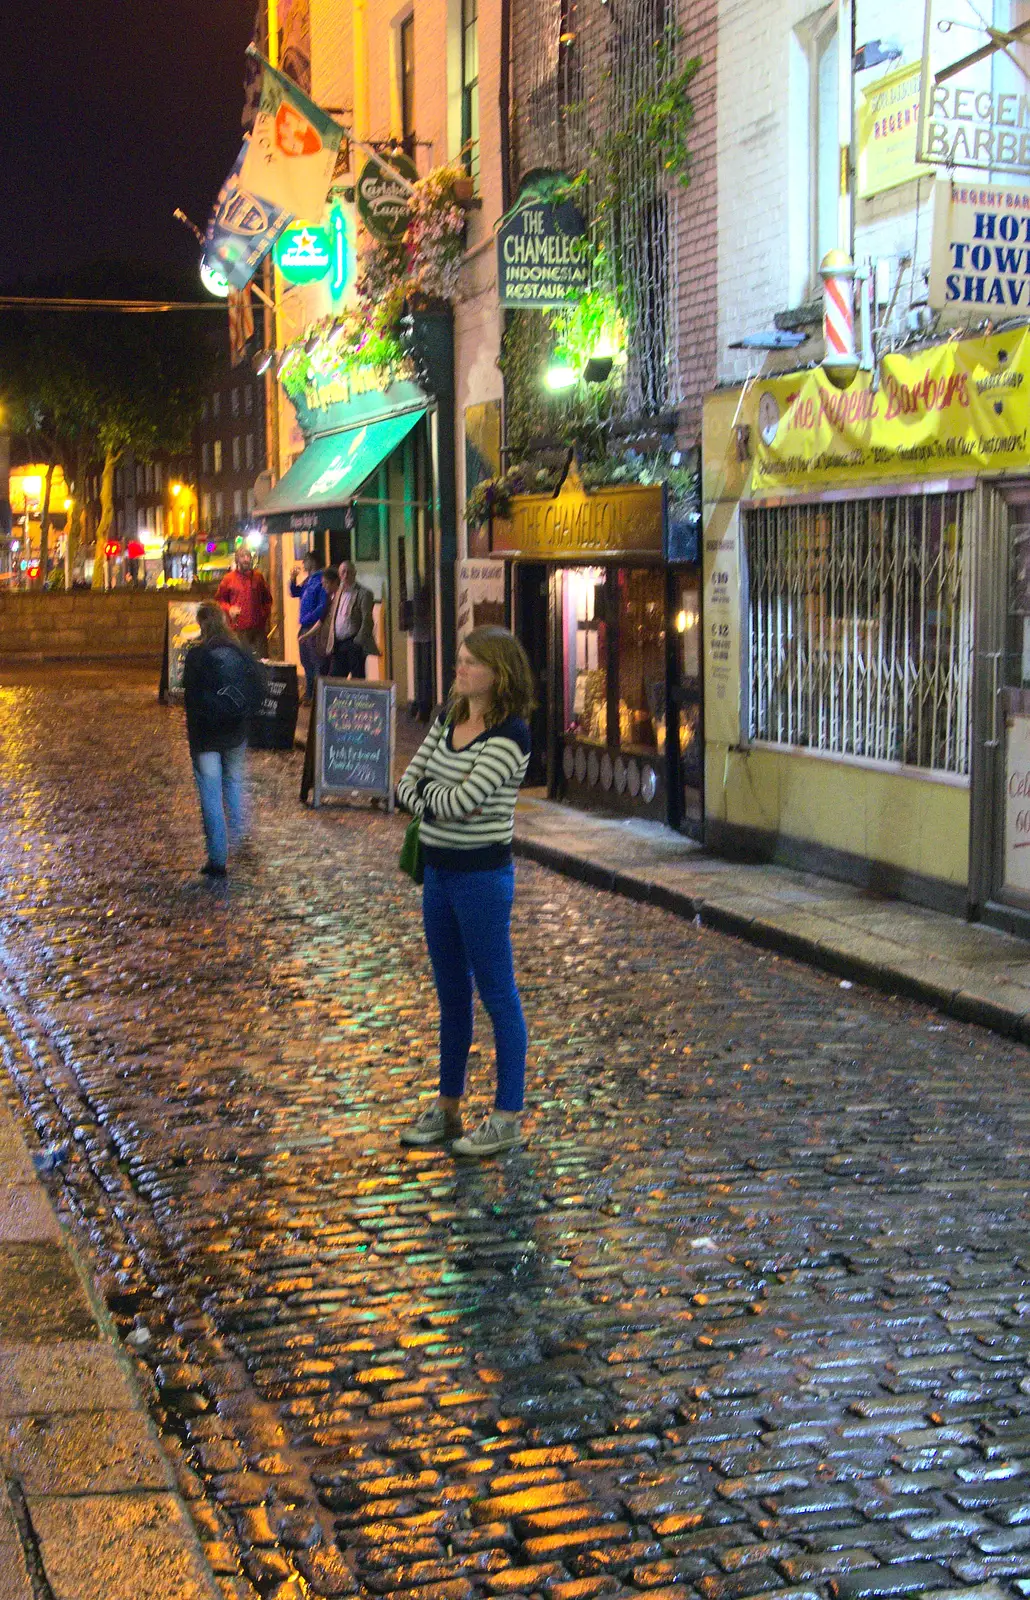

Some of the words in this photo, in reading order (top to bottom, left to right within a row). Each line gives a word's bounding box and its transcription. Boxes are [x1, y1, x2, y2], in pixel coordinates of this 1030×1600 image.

[874, 104, 919, 140] REGENT
[522, 211, 545, 235] THE
[786, 391, 815, 431] The
[884, 368, 970, 420] Barbers
